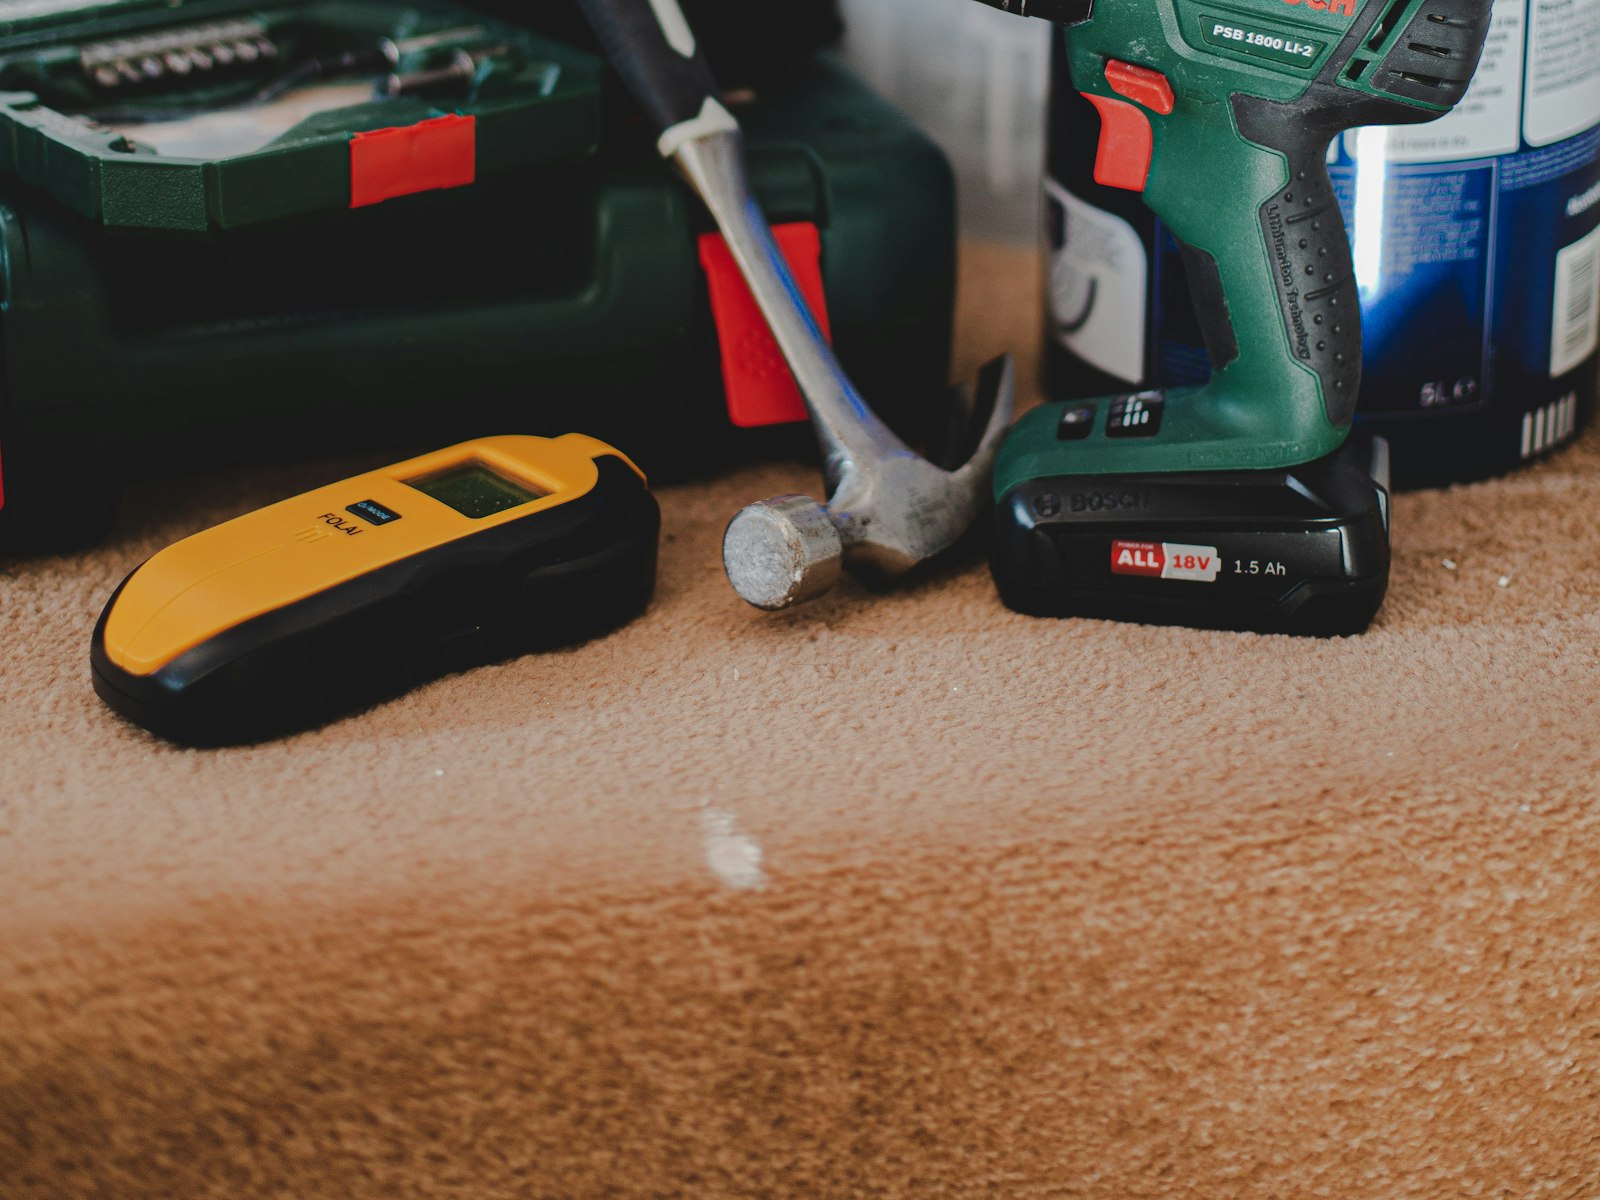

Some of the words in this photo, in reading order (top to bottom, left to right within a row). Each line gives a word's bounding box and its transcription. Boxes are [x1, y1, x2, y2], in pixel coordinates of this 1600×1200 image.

[1212, 24, 1243, 42] PSB
[1245, 31, 1283, 51] 1800
[1286, 287, 1312, 361] Technology
[317, 512, 364, 536] FOLAI
[1117, 549, 1160, 568] ALL
[1172, 554, 1211, 571] 18V
[1234, 559, 1260, 575] 1.5
[1264, 561, 1287, 576] Ah
